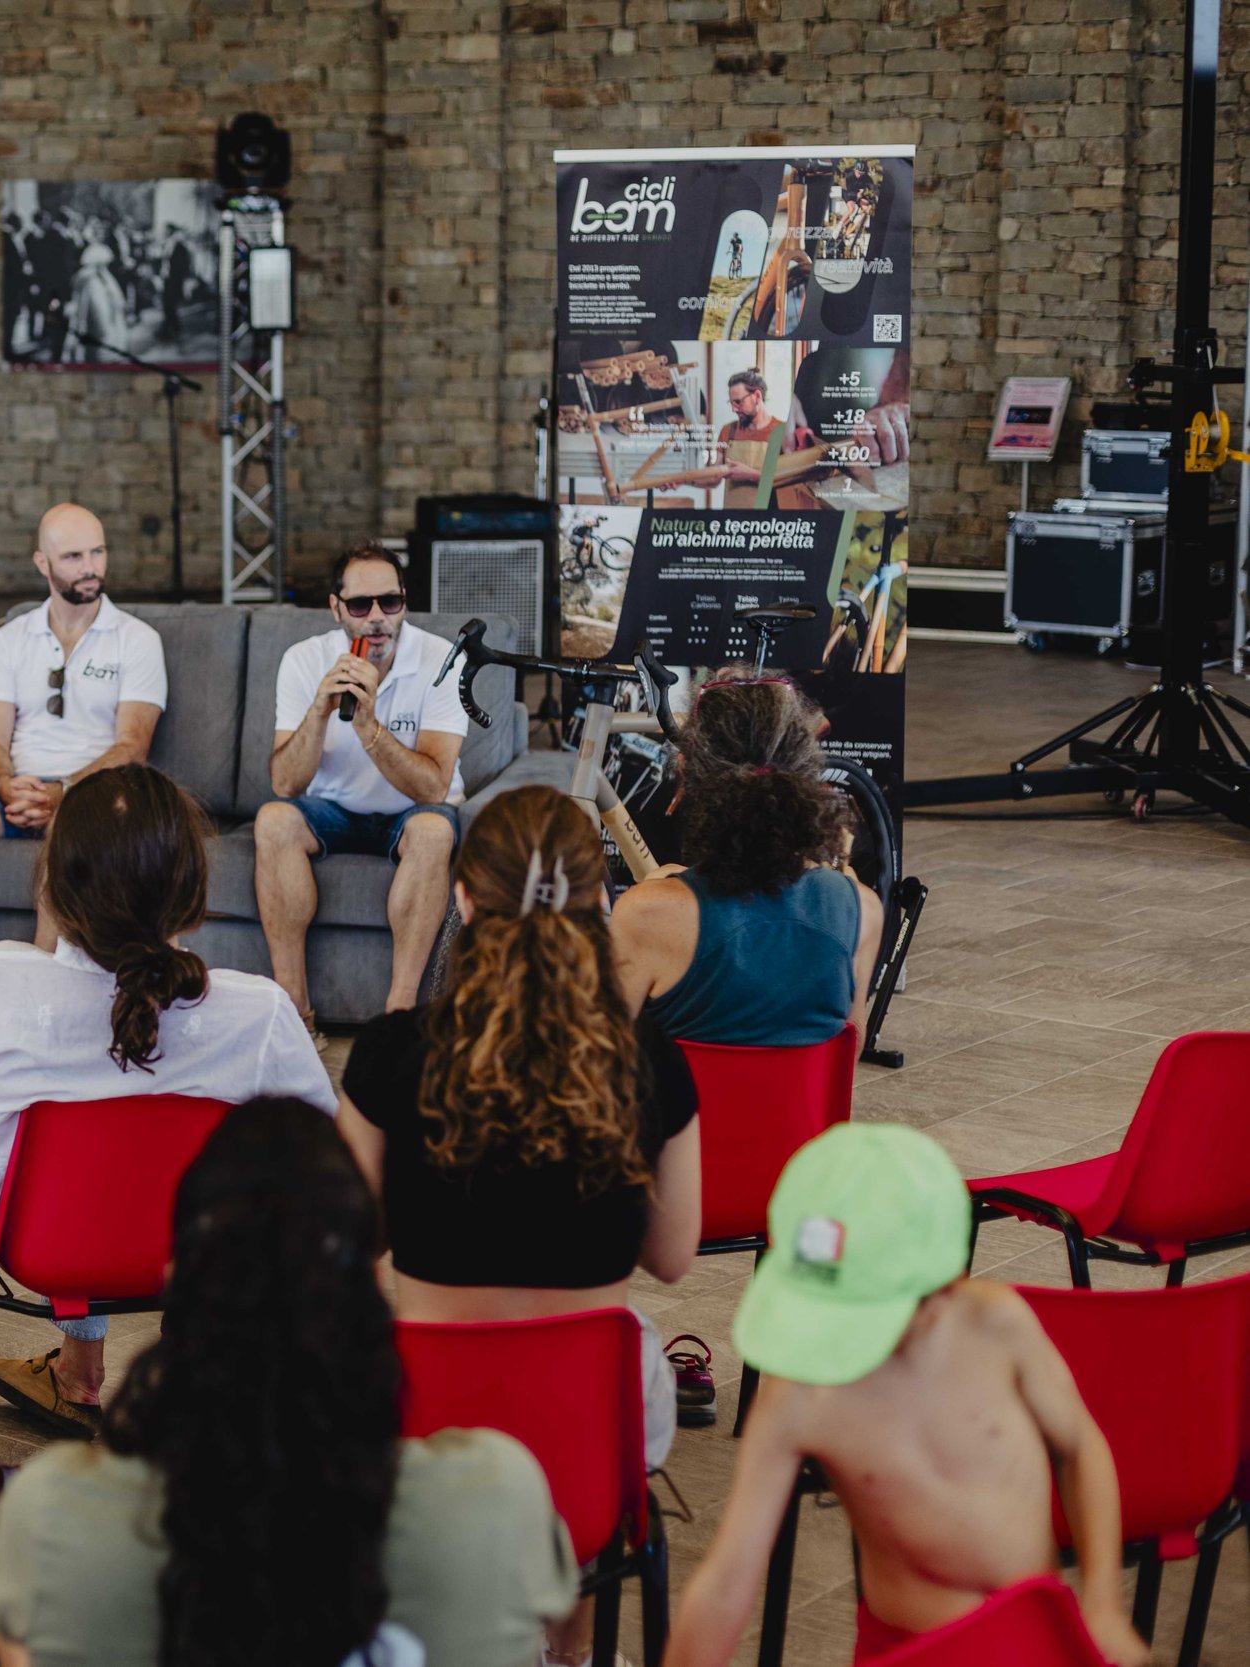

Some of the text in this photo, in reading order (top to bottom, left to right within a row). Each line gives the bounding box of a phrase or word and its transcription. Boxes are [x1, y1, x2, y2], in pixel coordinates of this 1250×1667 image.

[624, 175, 677, 200] cicli
[570, 177, 676, 233] bam
[839, 371, 861, 386] +5
[833, 408, 866, 424] +18
[828, 446, 870, 461] +100
[842, 477, 853, 492] 1
[651, 517, 817, 537] Natura e tecnologia:
[652, 531, 815, 551] un'alchimia perfetta
[389, 720, 416, 731] am
